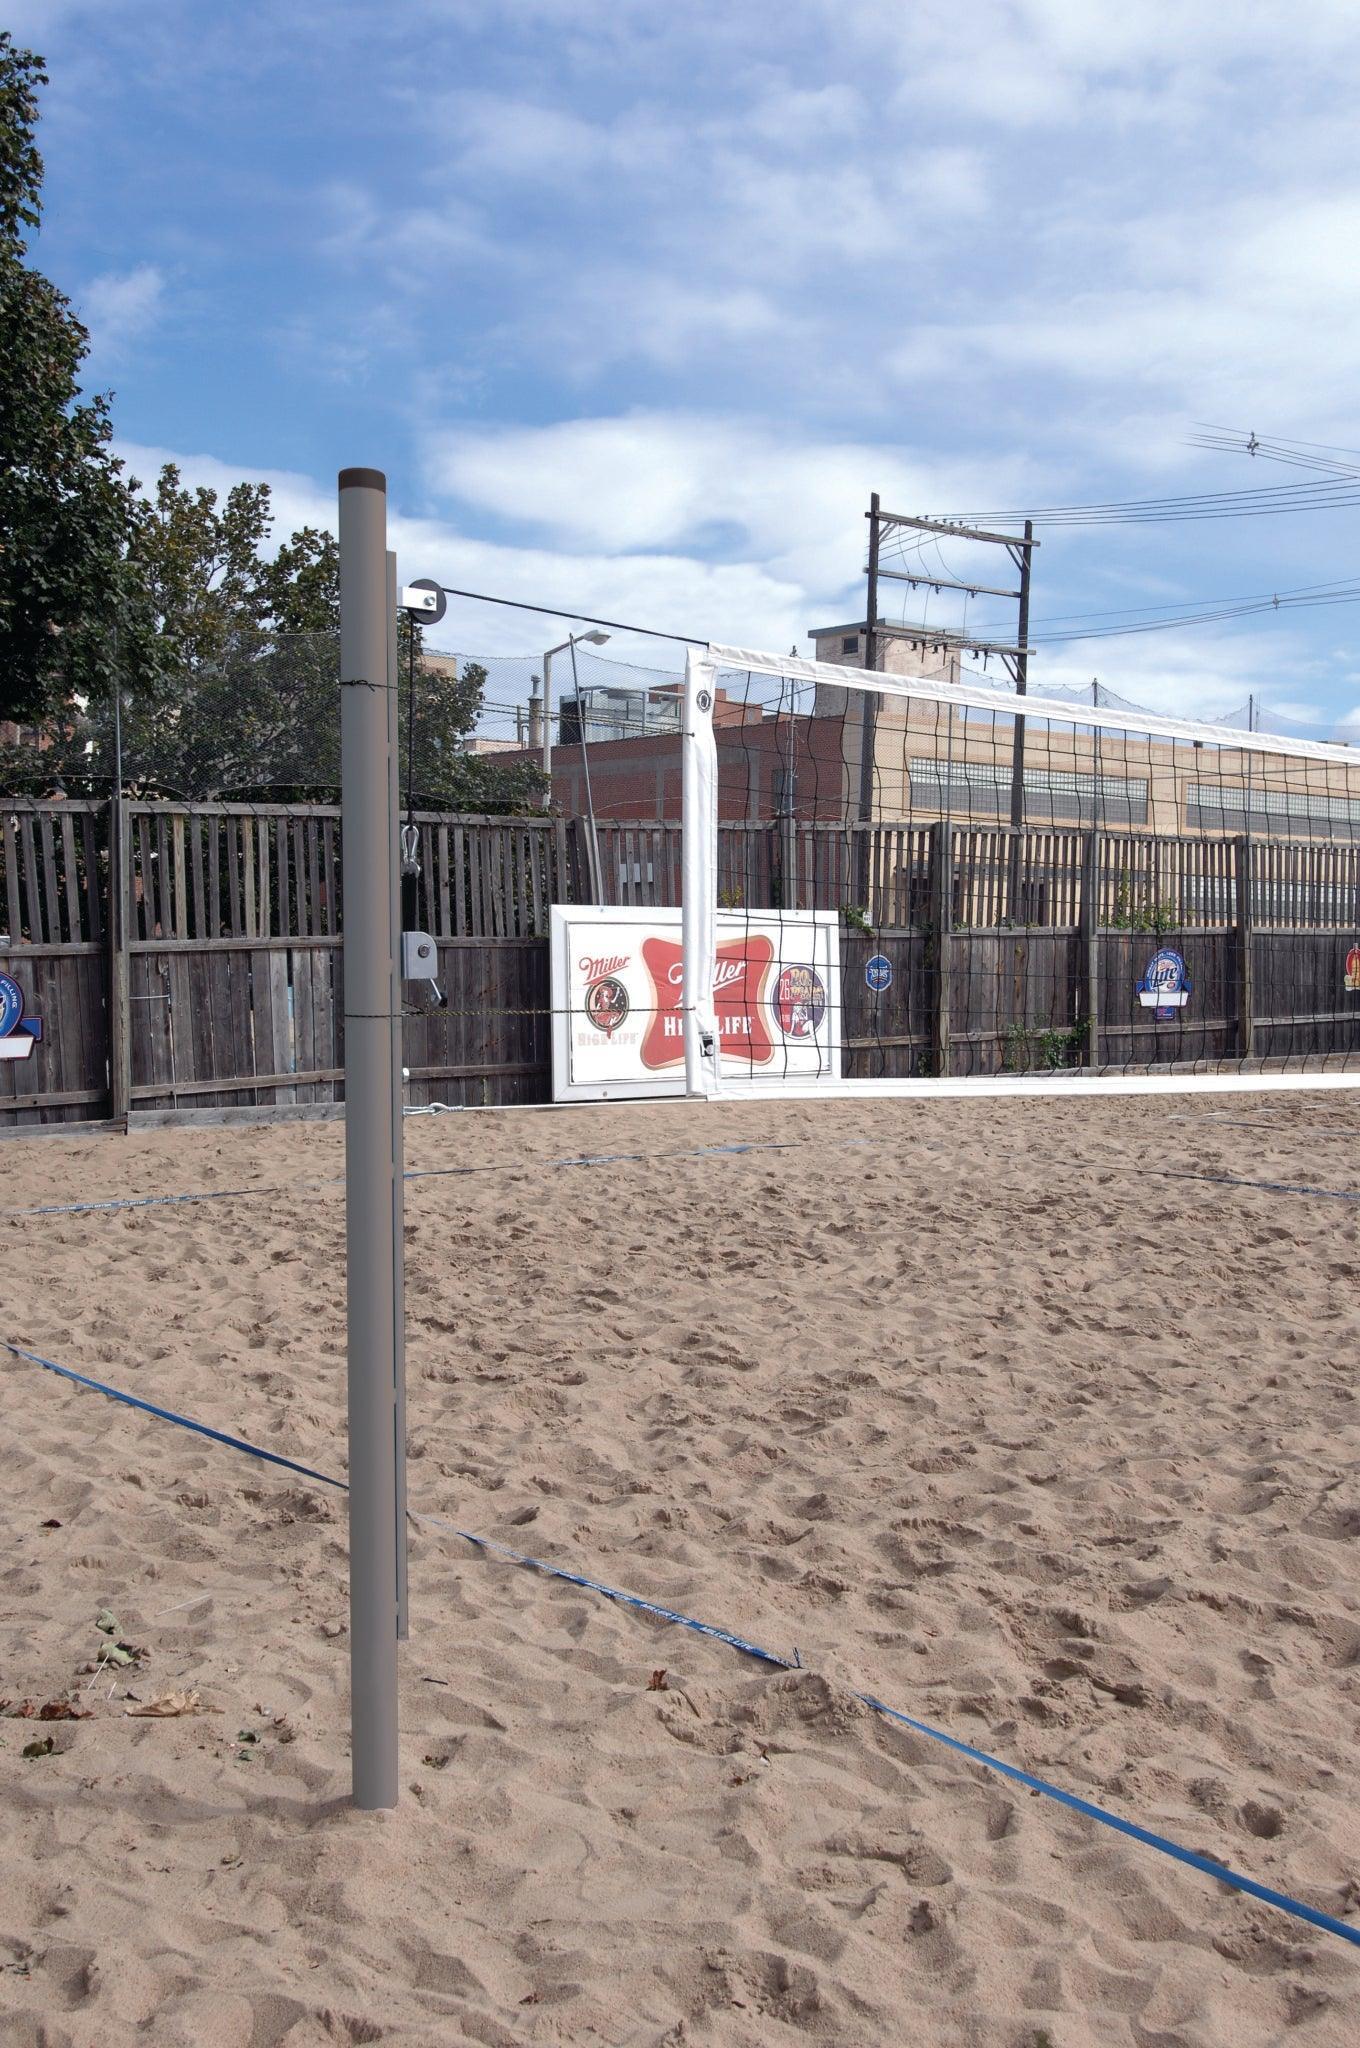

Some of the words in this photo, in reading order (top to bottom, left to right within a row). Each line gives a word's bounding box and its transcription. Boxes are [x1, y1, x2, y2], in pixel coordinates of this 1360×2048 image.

[579, 956, 631, 981] Miller
[1151, 967, 1178, 988] Lite
[1, 979, 18, 1009] FILLING
[780, 979, 790, 1000] 26
[714, 1015, 752, 1035] LIFE
[700, 1625, 734, 1643] MILLER
[732, 1639, 754, 1651] LITE
